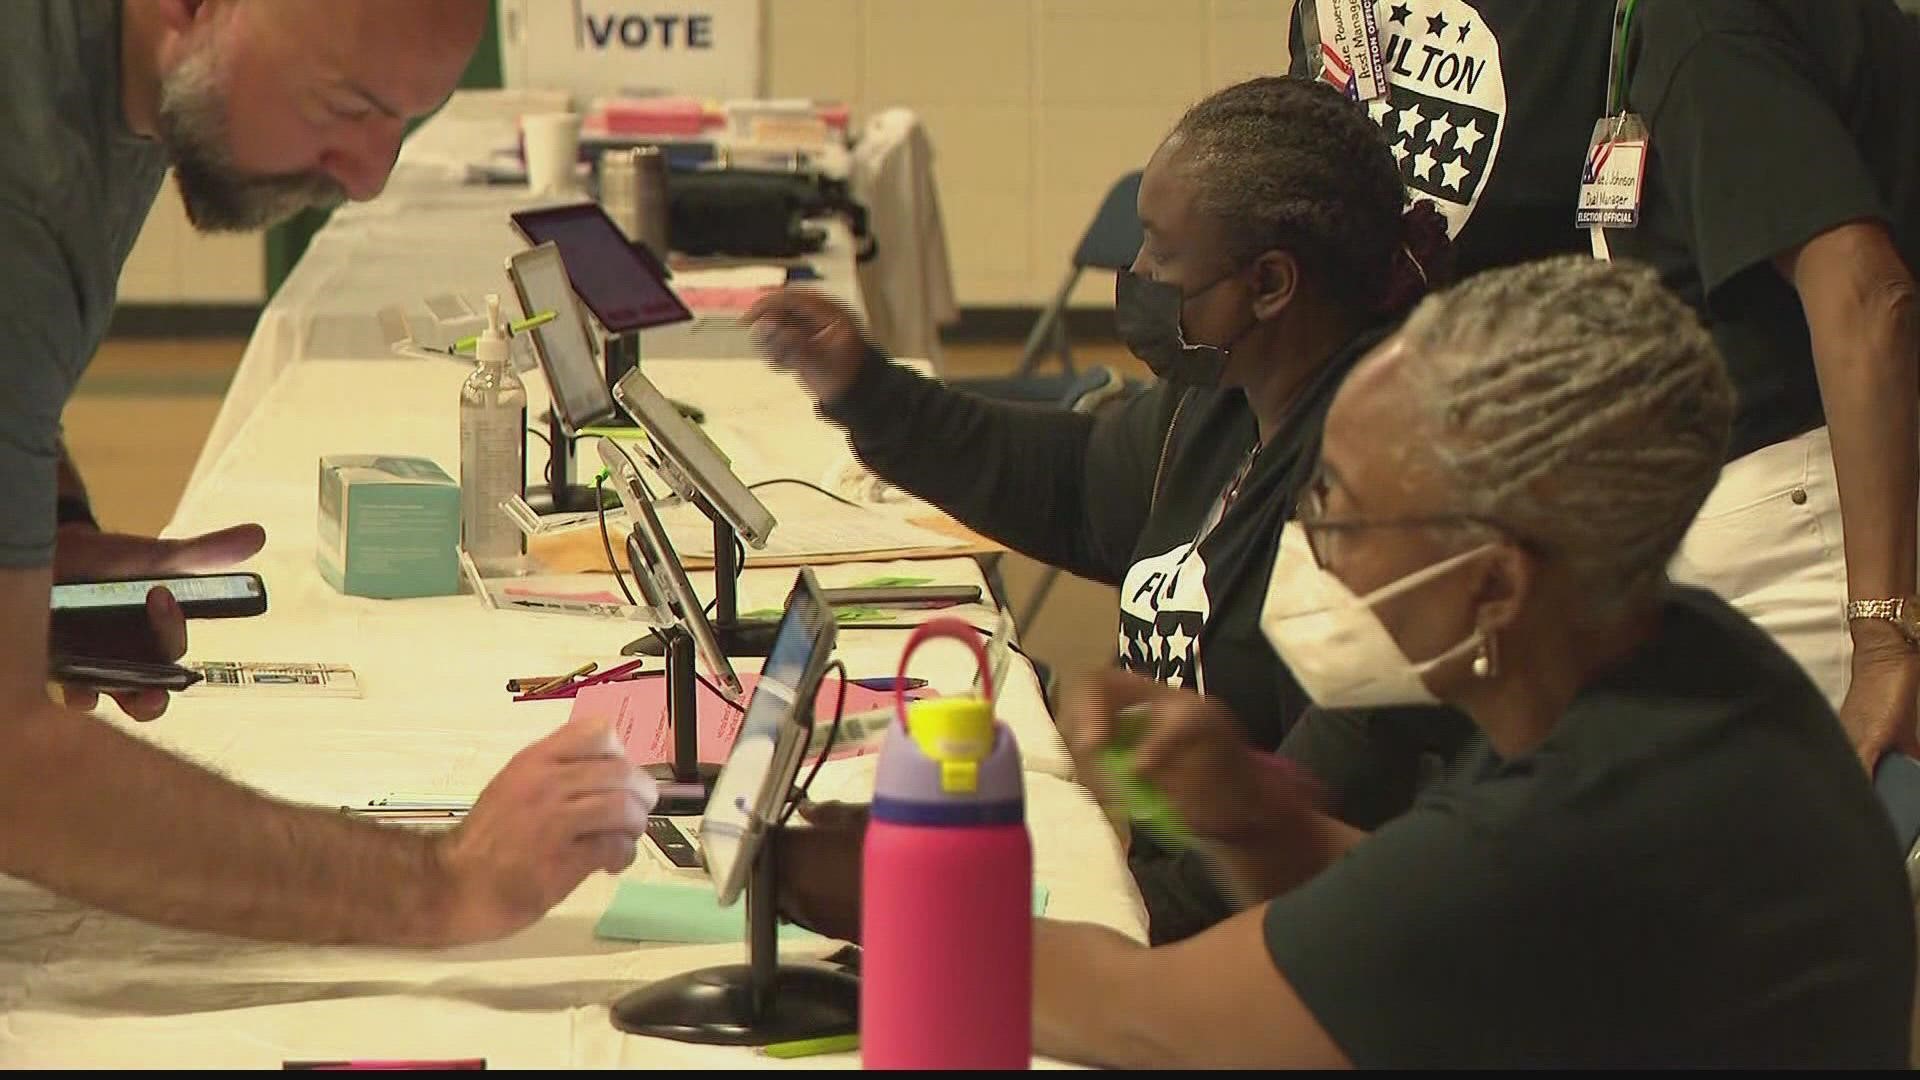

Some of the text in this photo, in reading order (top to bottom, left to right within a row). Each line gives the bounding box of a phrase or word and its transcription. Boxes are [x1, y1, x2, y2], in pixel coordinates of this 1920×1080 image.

[586, 15, 713, 48] VOTE
[1369, 37, 1386, 93] ELECTION
[1577, 211, 1633, 223] ELECTION OFFICIAL
